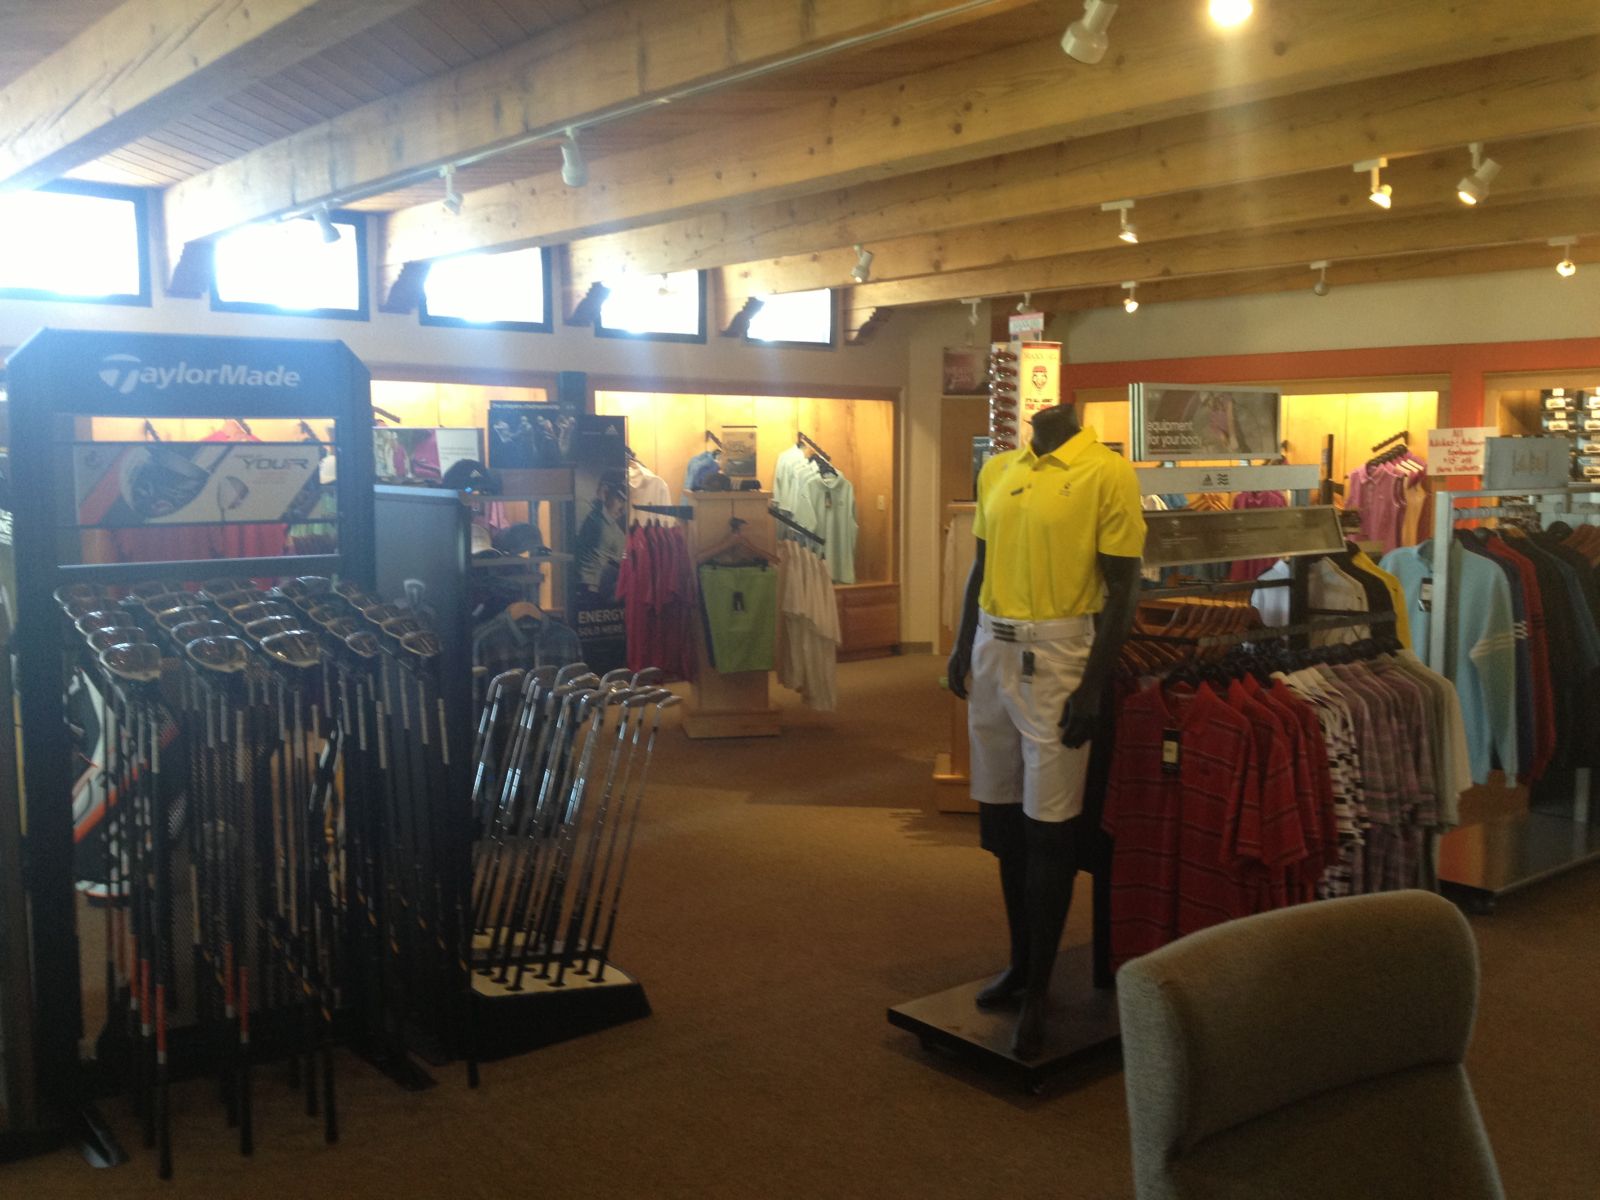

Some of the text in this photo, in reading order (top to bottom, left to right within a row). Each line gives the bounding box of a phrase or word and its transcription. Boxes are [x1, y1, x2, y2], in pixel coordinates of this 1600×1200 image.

[99, 354, 301, 393] TaylorMade
[1147, 419, 1193, 432] equipment
[1162, 435, 1180, 448] your
